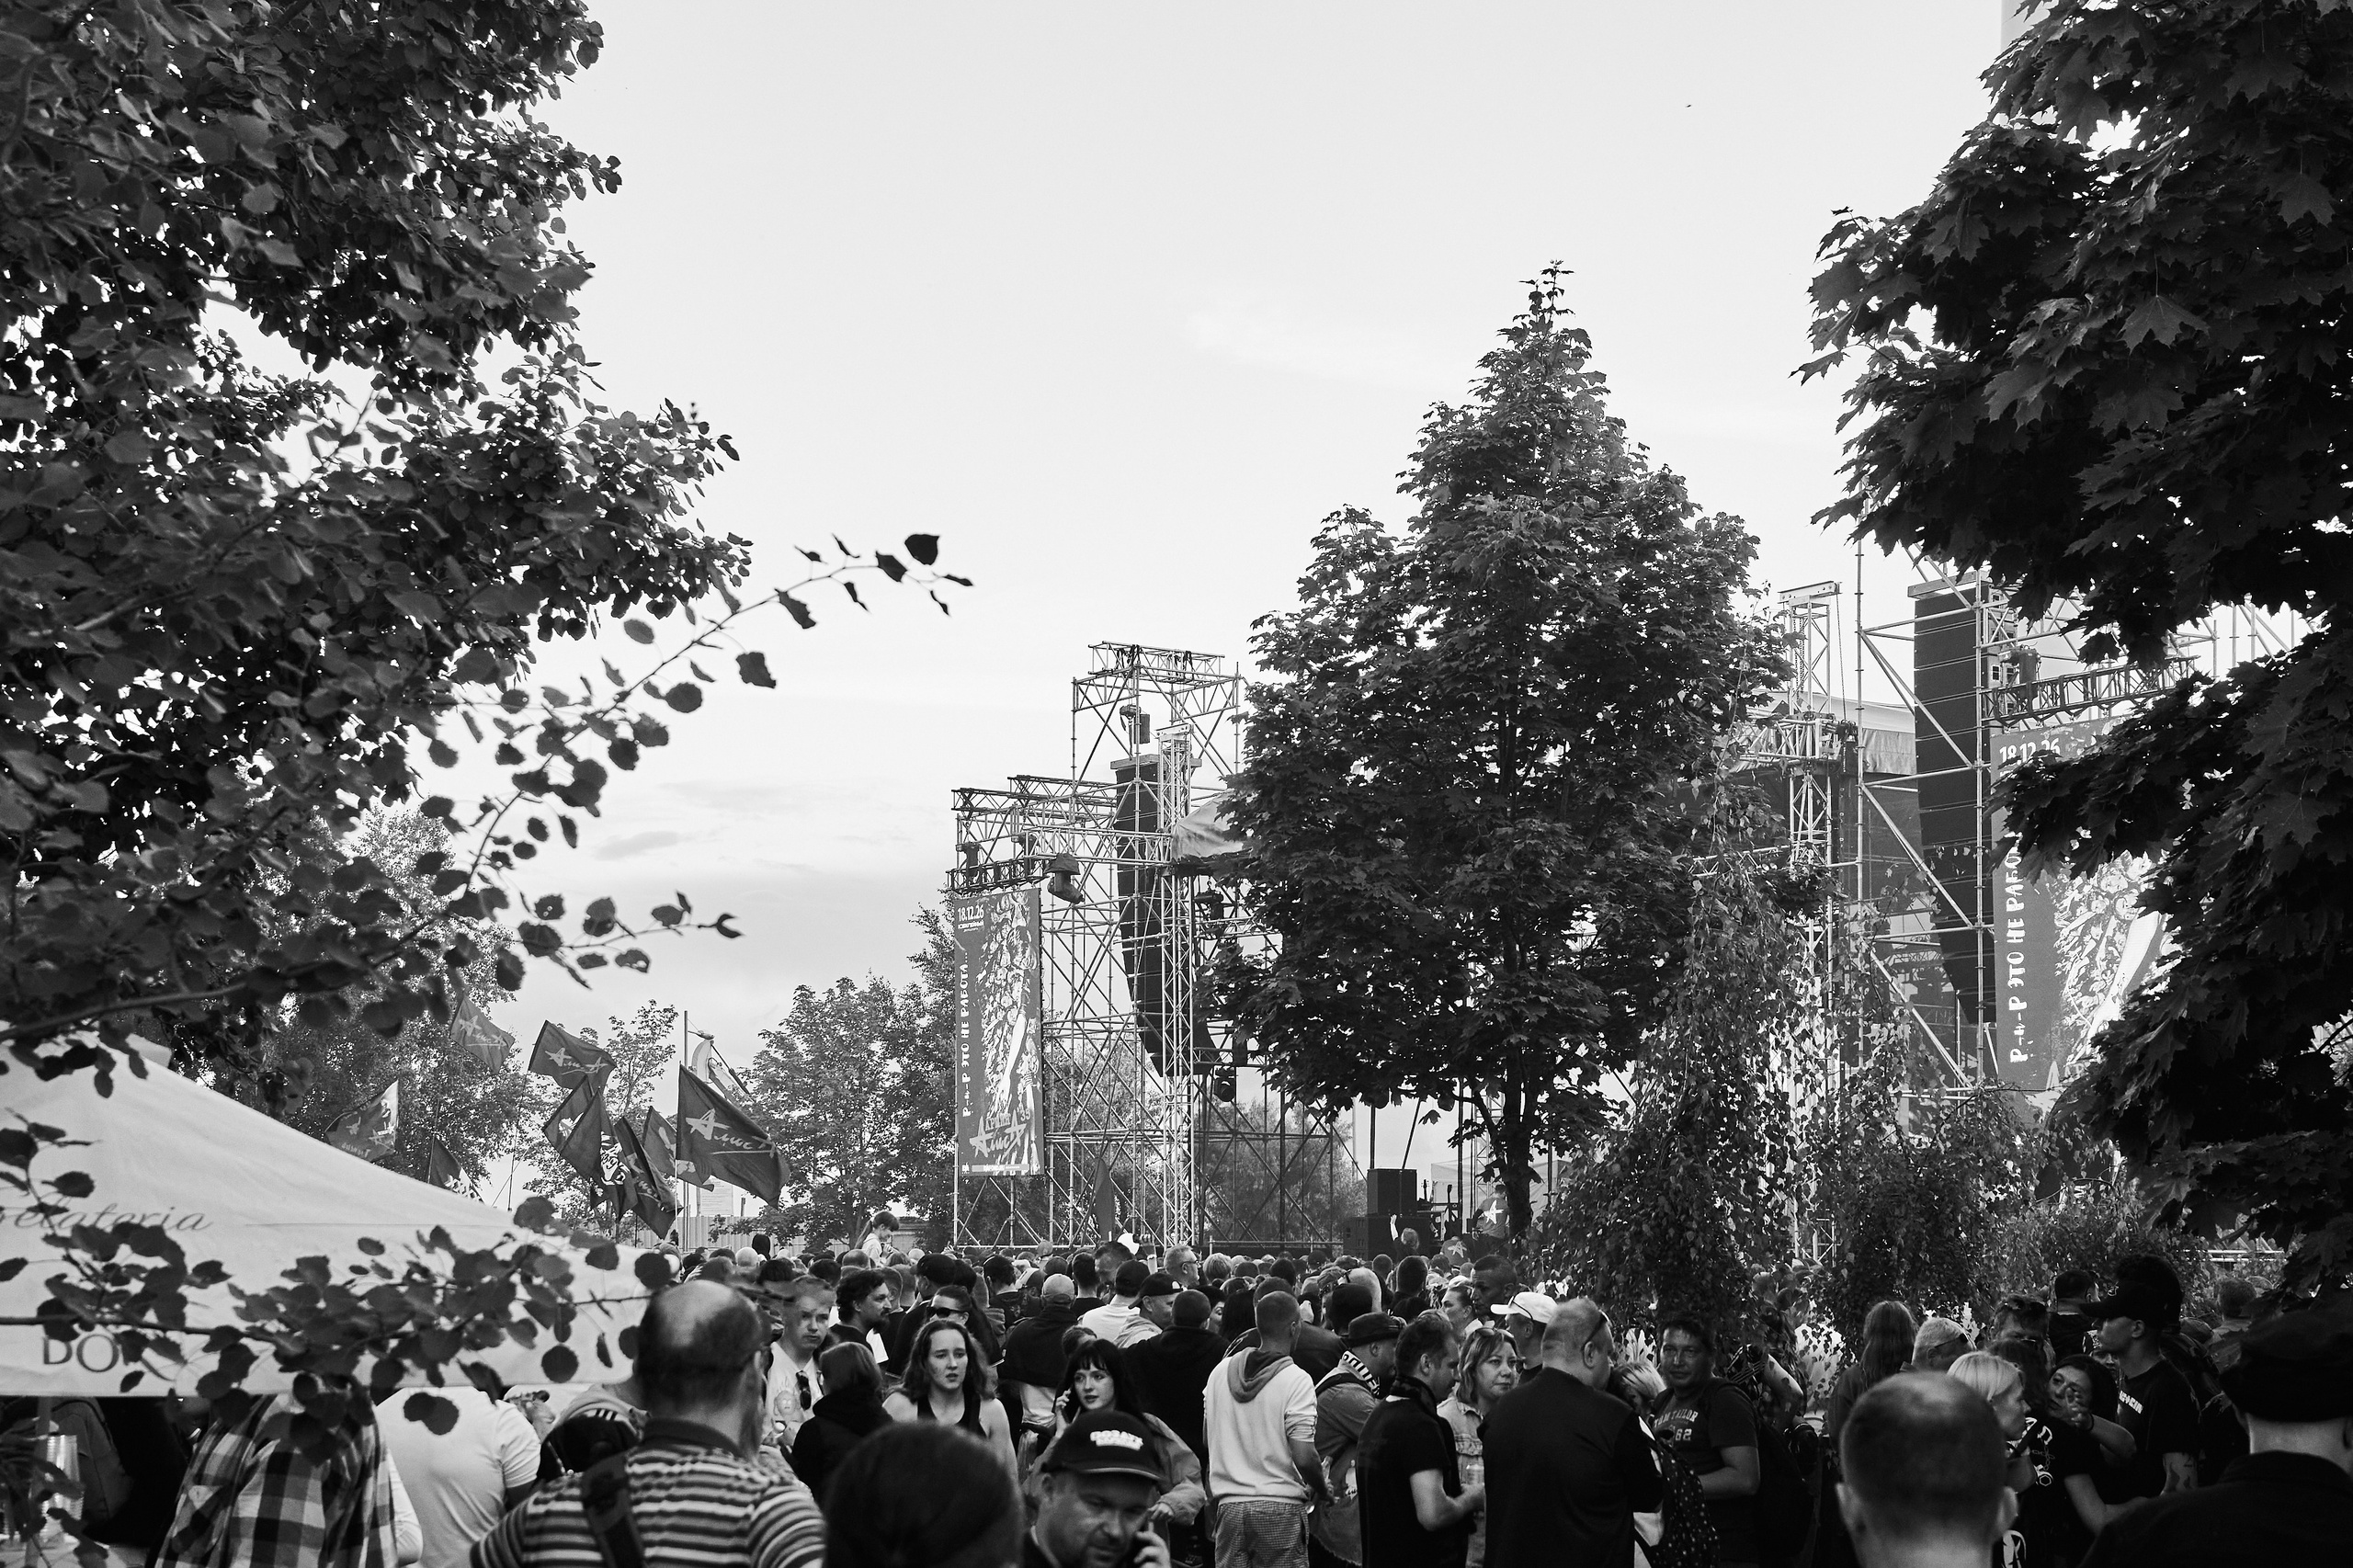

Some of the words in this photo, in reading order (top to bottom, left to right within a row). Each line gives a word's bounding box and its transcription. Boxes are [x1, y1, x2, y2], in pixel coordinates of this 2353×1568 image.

[958, 904, 984, 922] 18.12.26
[2006, 917, 2026, 943] НЕ
[2007, 951, 2025, 988] ЭТО
[961, 1021, 970, 1039] НЕ
[961, 1043, 971, 1067] ЭТО
[0, 1191, 213, 1232] elateria
[1671, 1408, 1699, 1423] TAILOR
